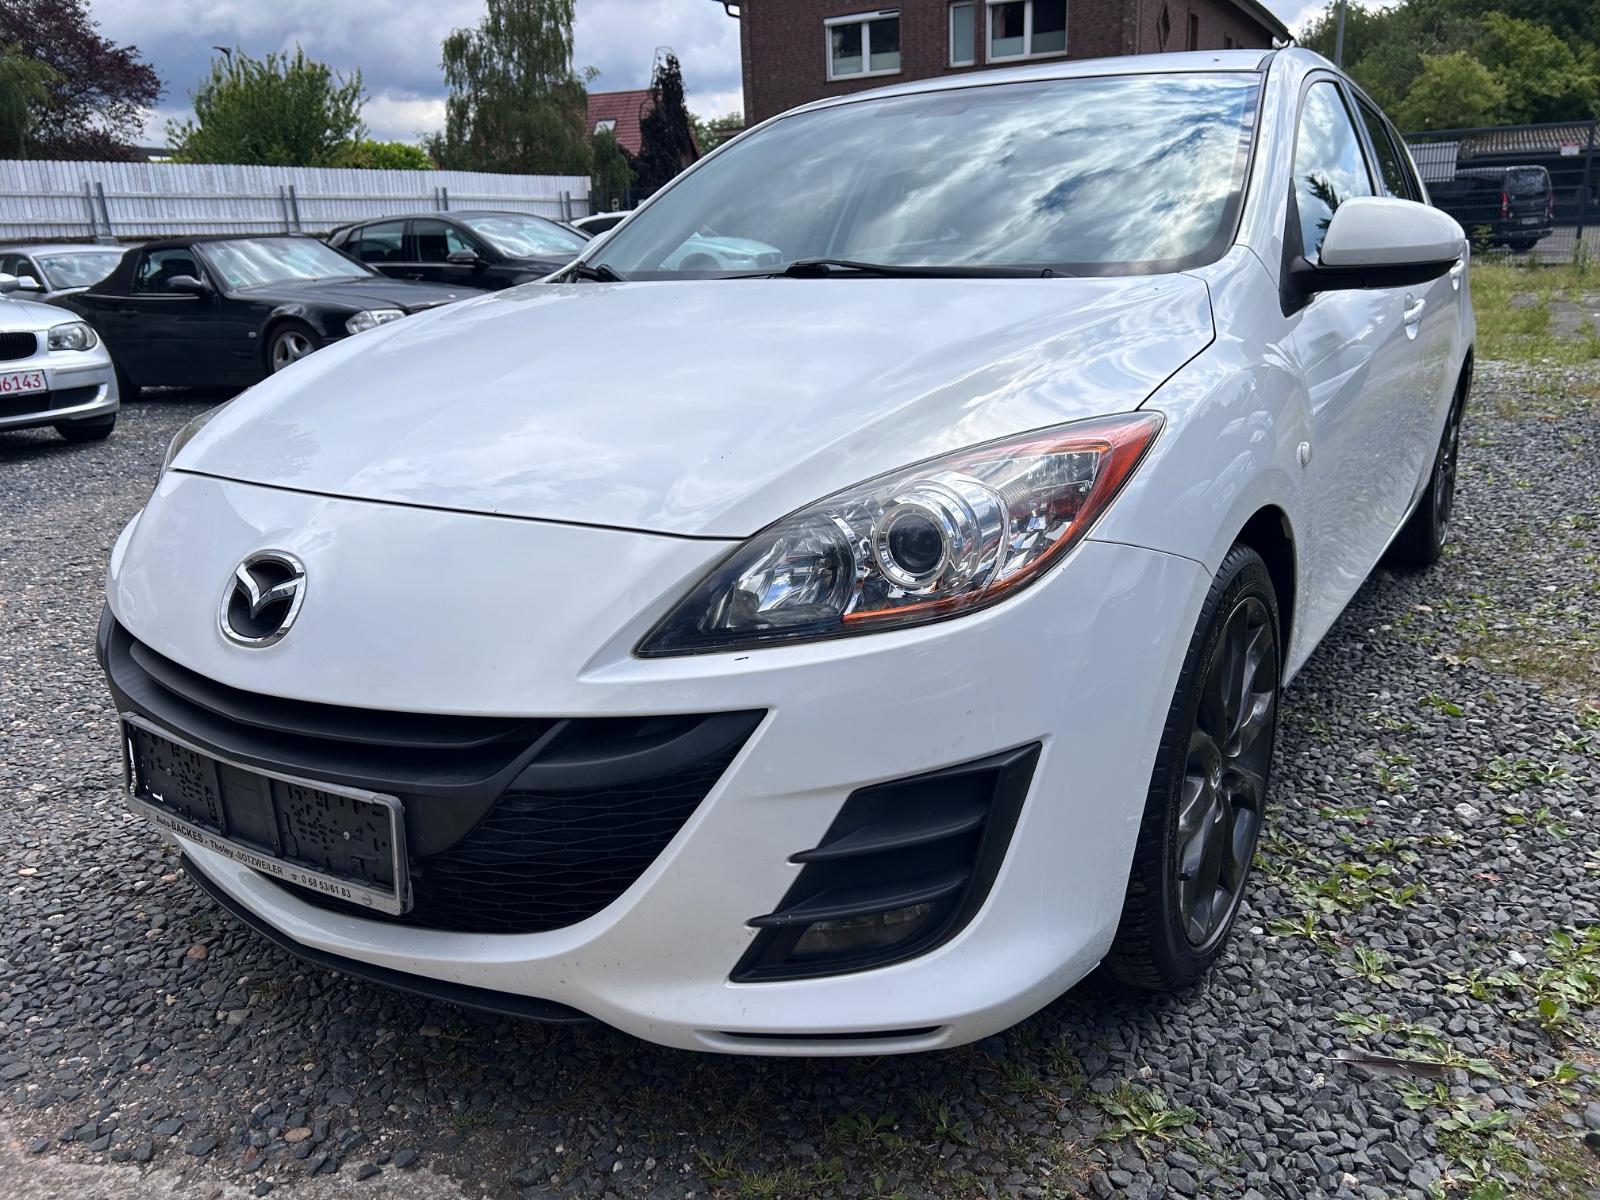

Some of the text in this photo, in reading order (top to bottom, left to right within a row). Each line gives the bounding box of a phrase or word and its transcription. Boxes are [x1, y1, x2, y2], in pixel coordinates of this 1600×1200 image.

[0, 374, 41, 392] 6143
[210, 840, 234, 858] Tholey
[341, 887, 352, 898] 83
